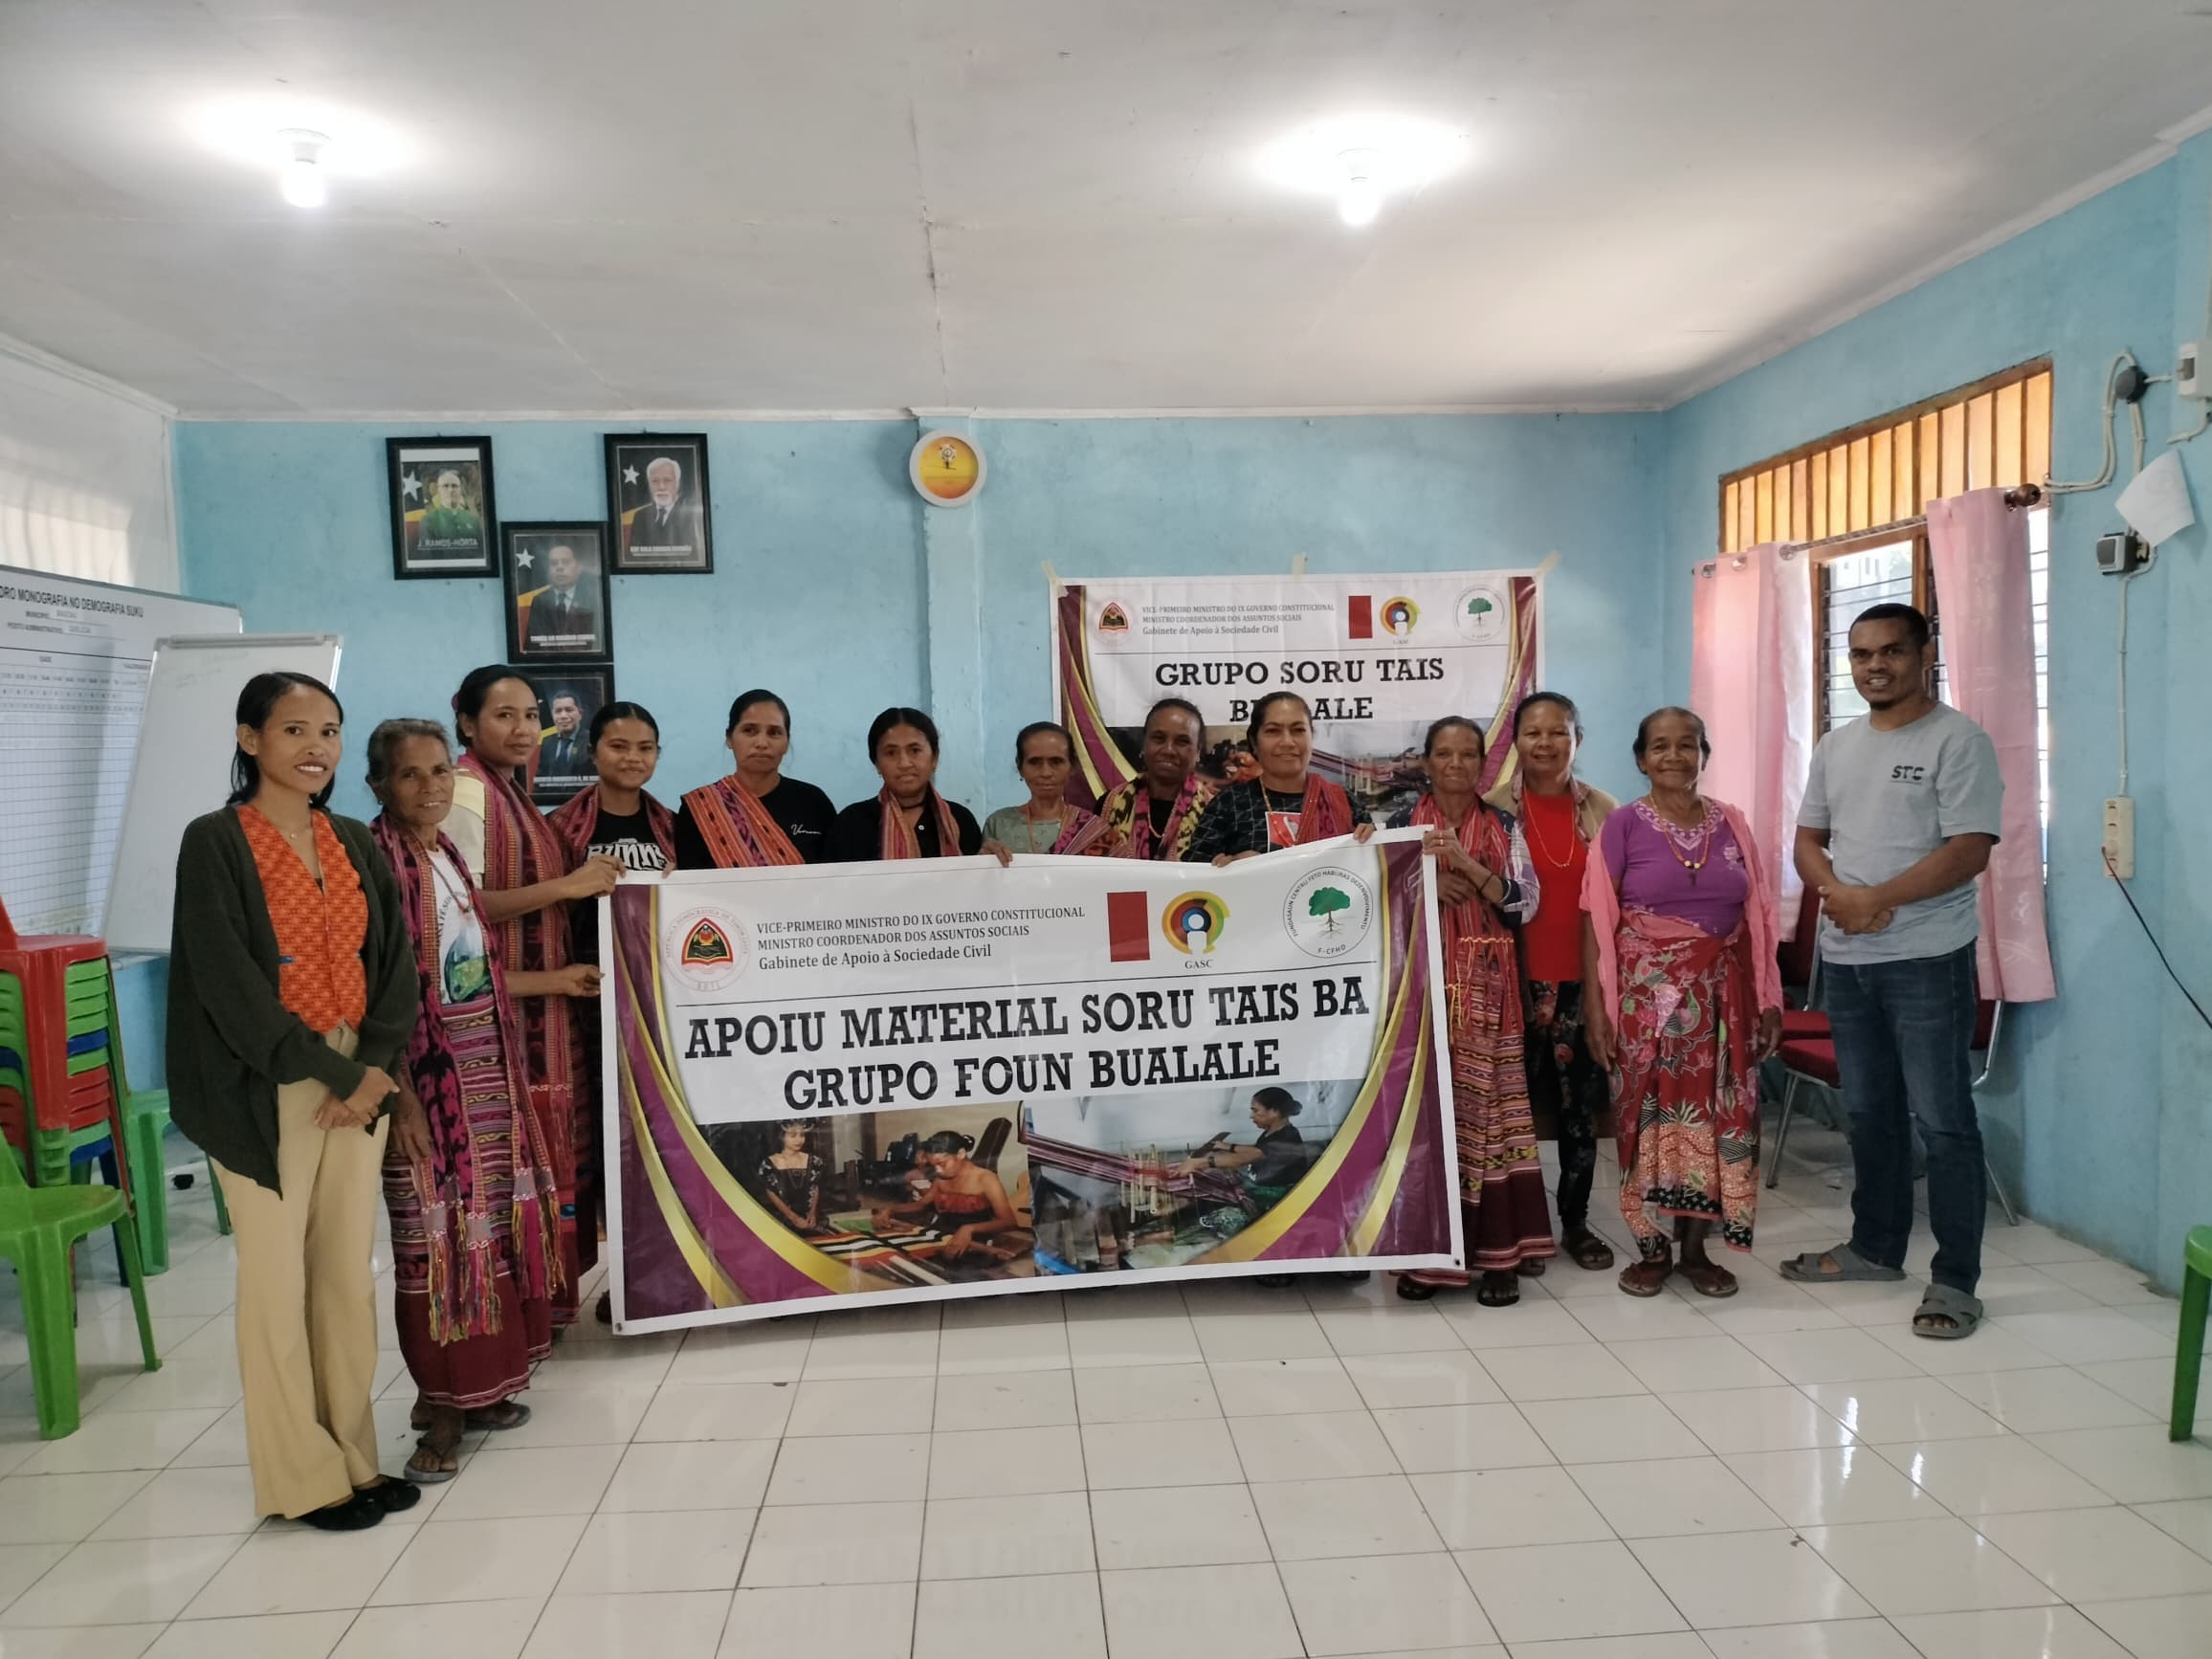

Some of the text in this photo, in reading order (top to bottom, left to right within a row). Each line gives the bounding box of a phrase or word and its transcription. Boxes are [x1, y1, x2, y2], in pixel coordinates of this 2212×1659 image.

[17, 588, 68, 606] MONOGRAFIA
[70, 596, 80, 609] NO
[81, 598, 125, 614] DEMOGRAFIA
[126, 605, 144, 618] SUKU
[1142, 626, 1178, 635] Gabinete
[1179, 626, 1188, 634] de
[1190, 627, 1213, 636] Apoio
[1221, 625, 1260, 634] Sociedade
[1262, 624, 1279, 633] Civil
[1155, 657, 1444, 686] GRUPO SORU TAIS
[757, 907, 1086, 934] VICE-PRIMEIRO MINISTRO DO IX GOVERNO CONSTITUCIONAL
[758, 925, 1029, 951] MINISTRO COORDENADOR DOS ASSUNTOS SOCIAIS
[759, 943, 991, 970] Gabinete de Apoio à Sociedade Civil
[1184, 959, 1213, 969] GASC
[684, 976, 1370, 1059] APOIU MATERIAL SORU TAIS BA
[784, 1038, 1280, 1110] GRUPO FOUN BUALALE
